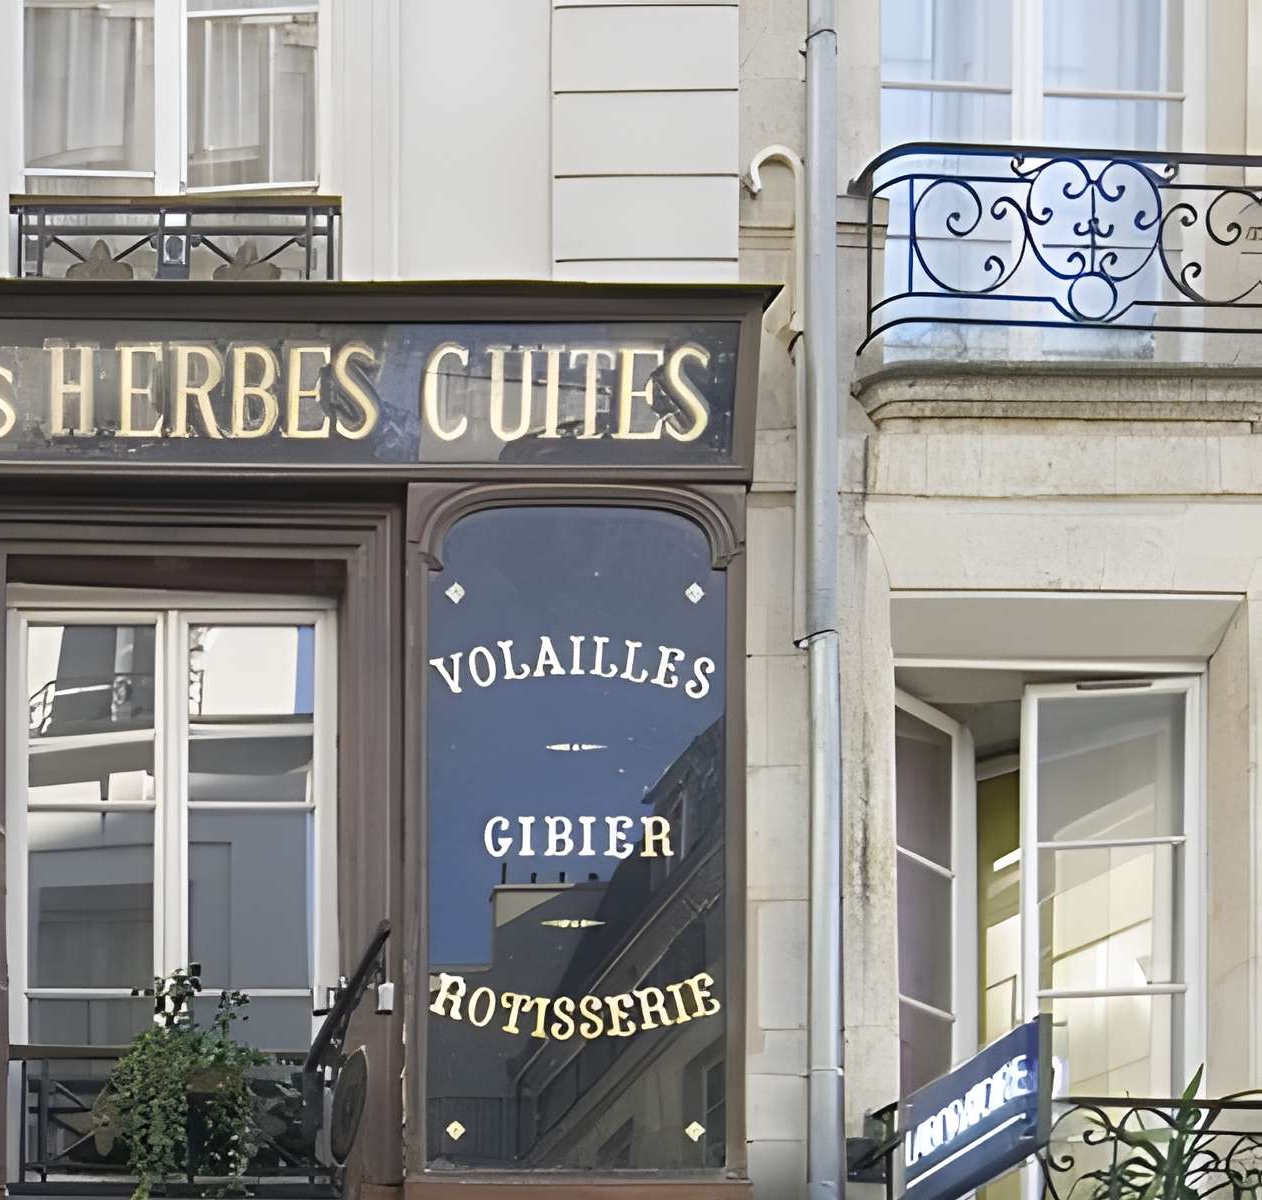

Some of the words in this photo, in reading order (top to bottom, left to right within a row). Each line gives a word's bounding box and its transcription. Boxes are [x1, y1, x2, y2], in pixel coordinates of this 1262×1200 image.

[43, 338, 378, 440] HERBES
[423, 340, 713, 441] CUITES
[429, 635, 715, 699] VOLAILLES
[484, 815, 674, 858] GIBIER
[429, 972, 720, 1041] ROTISSERIE
